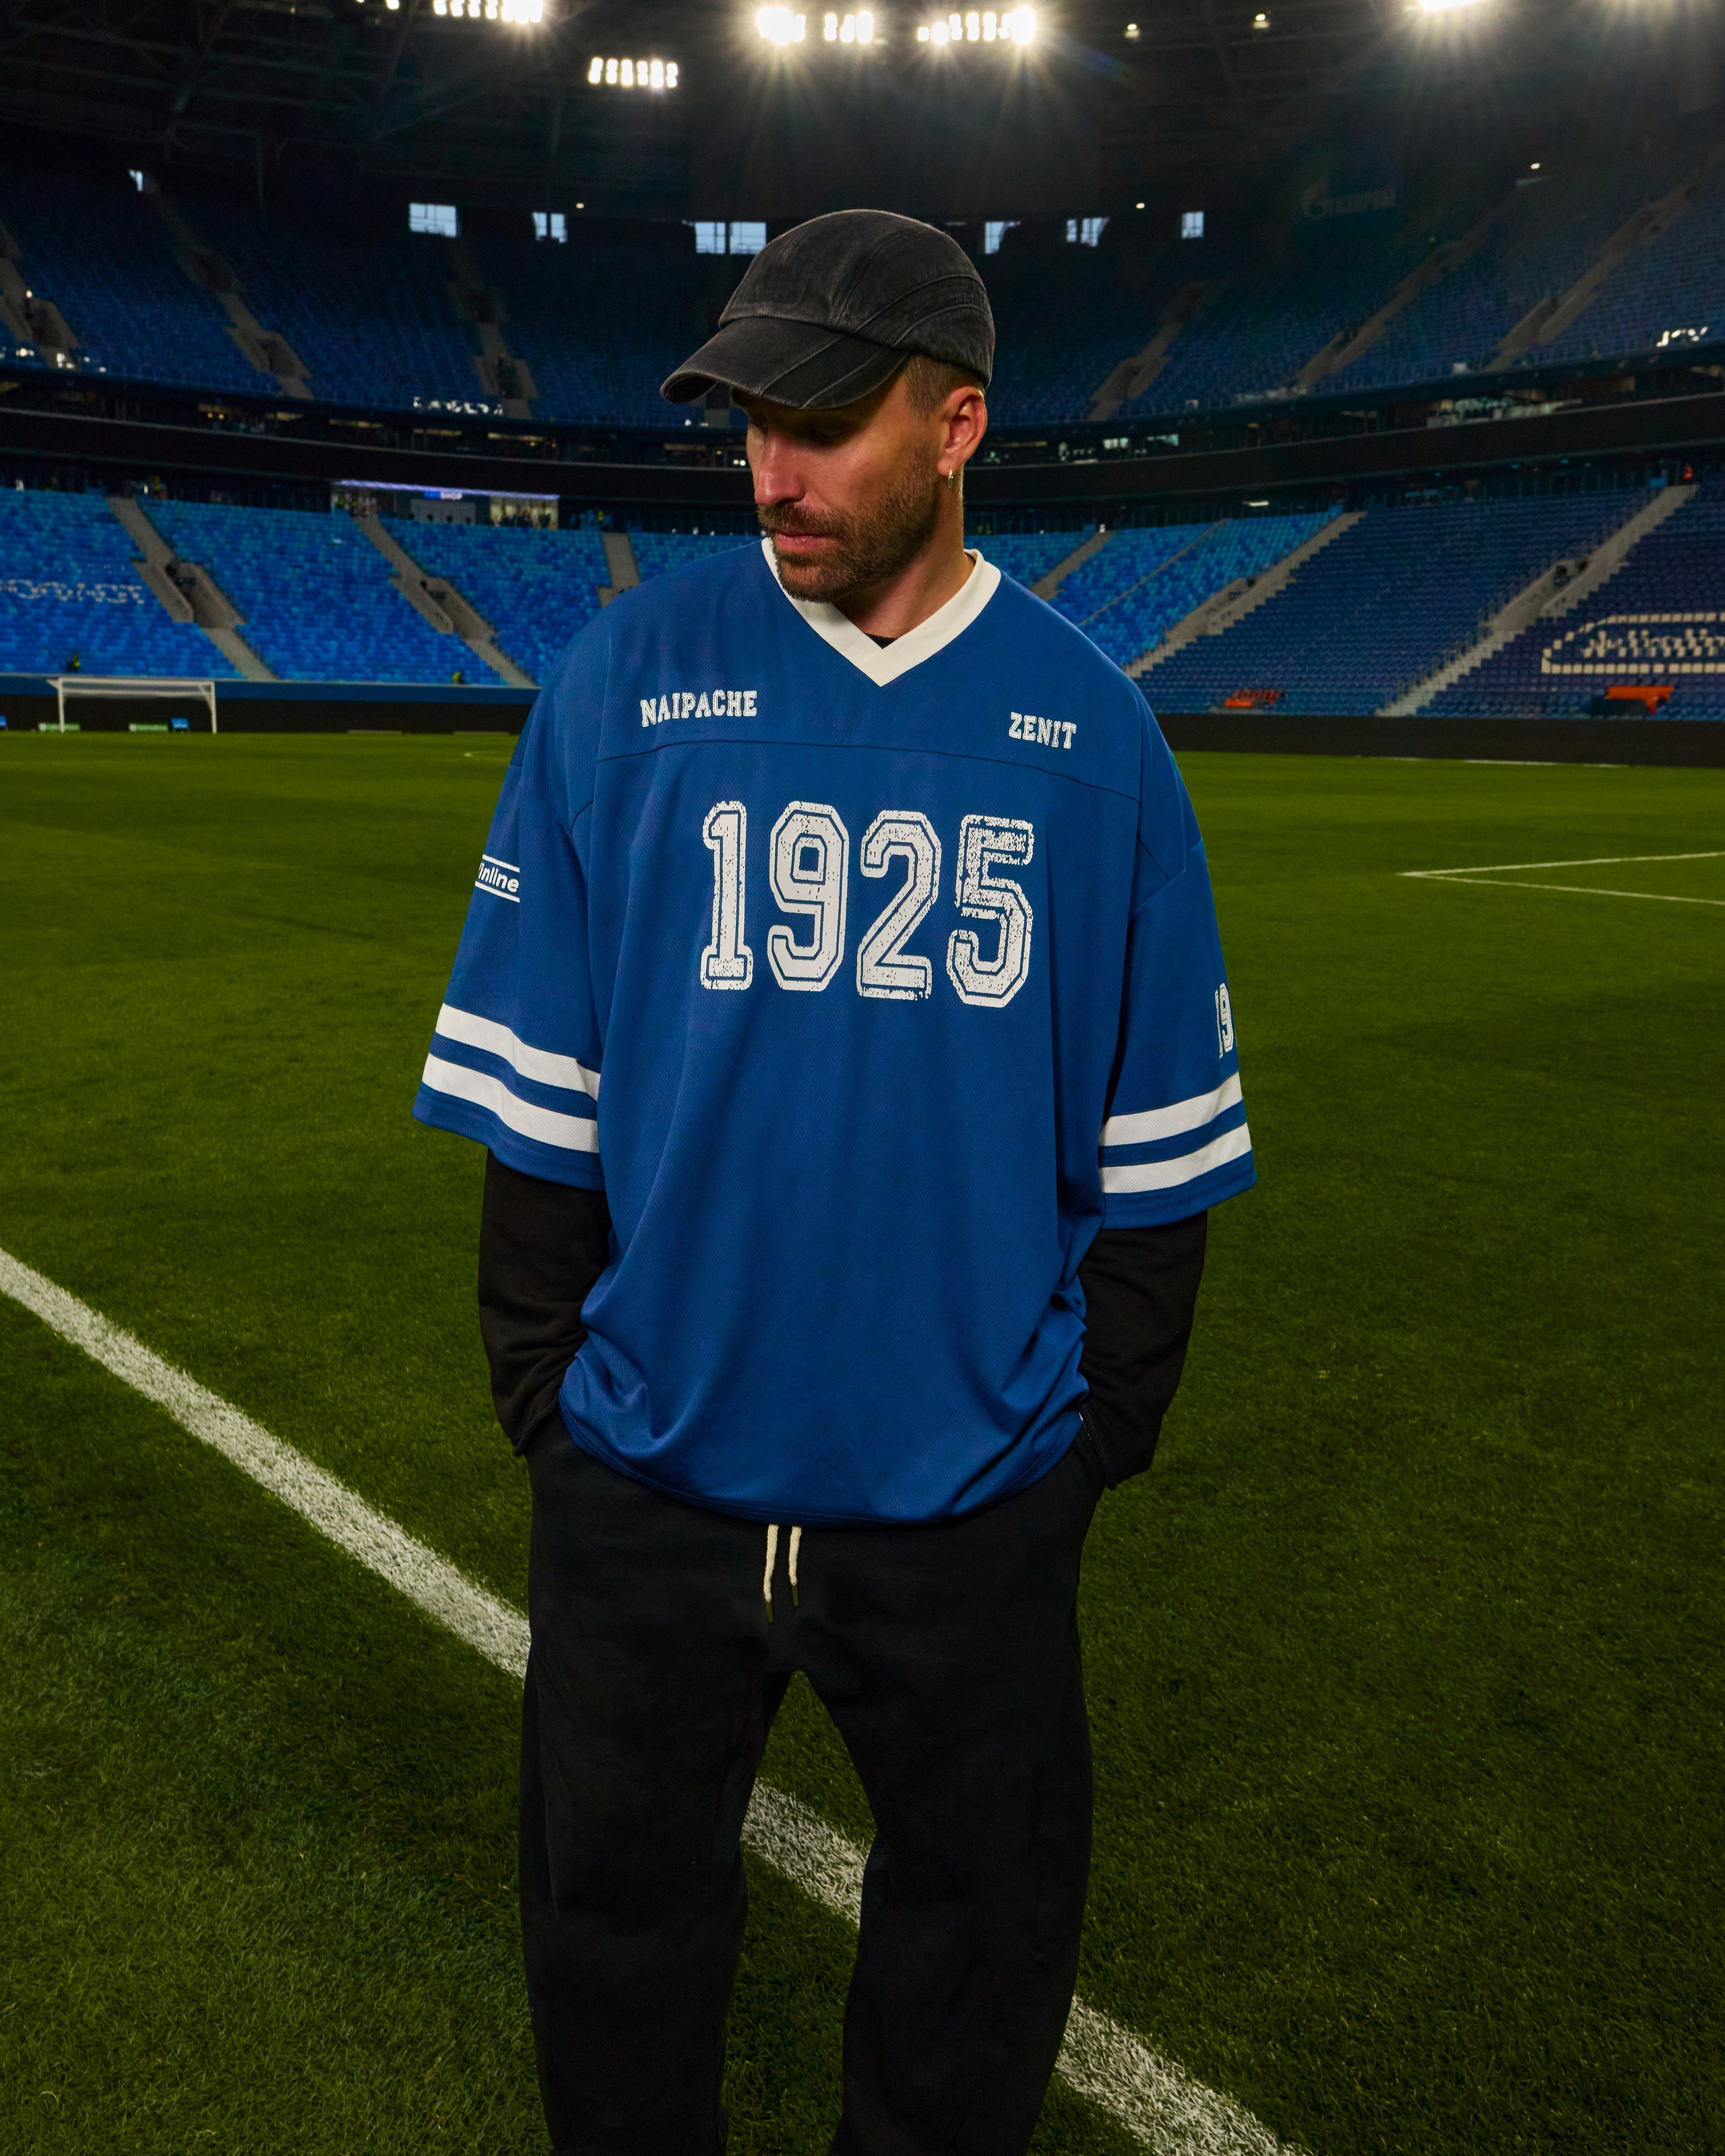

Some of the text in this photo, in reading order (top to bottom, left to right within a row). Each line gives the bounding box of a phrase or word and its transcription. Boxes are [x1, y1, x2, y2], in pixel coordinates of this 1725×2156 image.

[640, 689, 757, 728] NAIPACHE
[1009, 711, 1077, 749] ZENIT
[478, 862, 520, 893] inline
[700, 800, 1034, 1008] 1925
